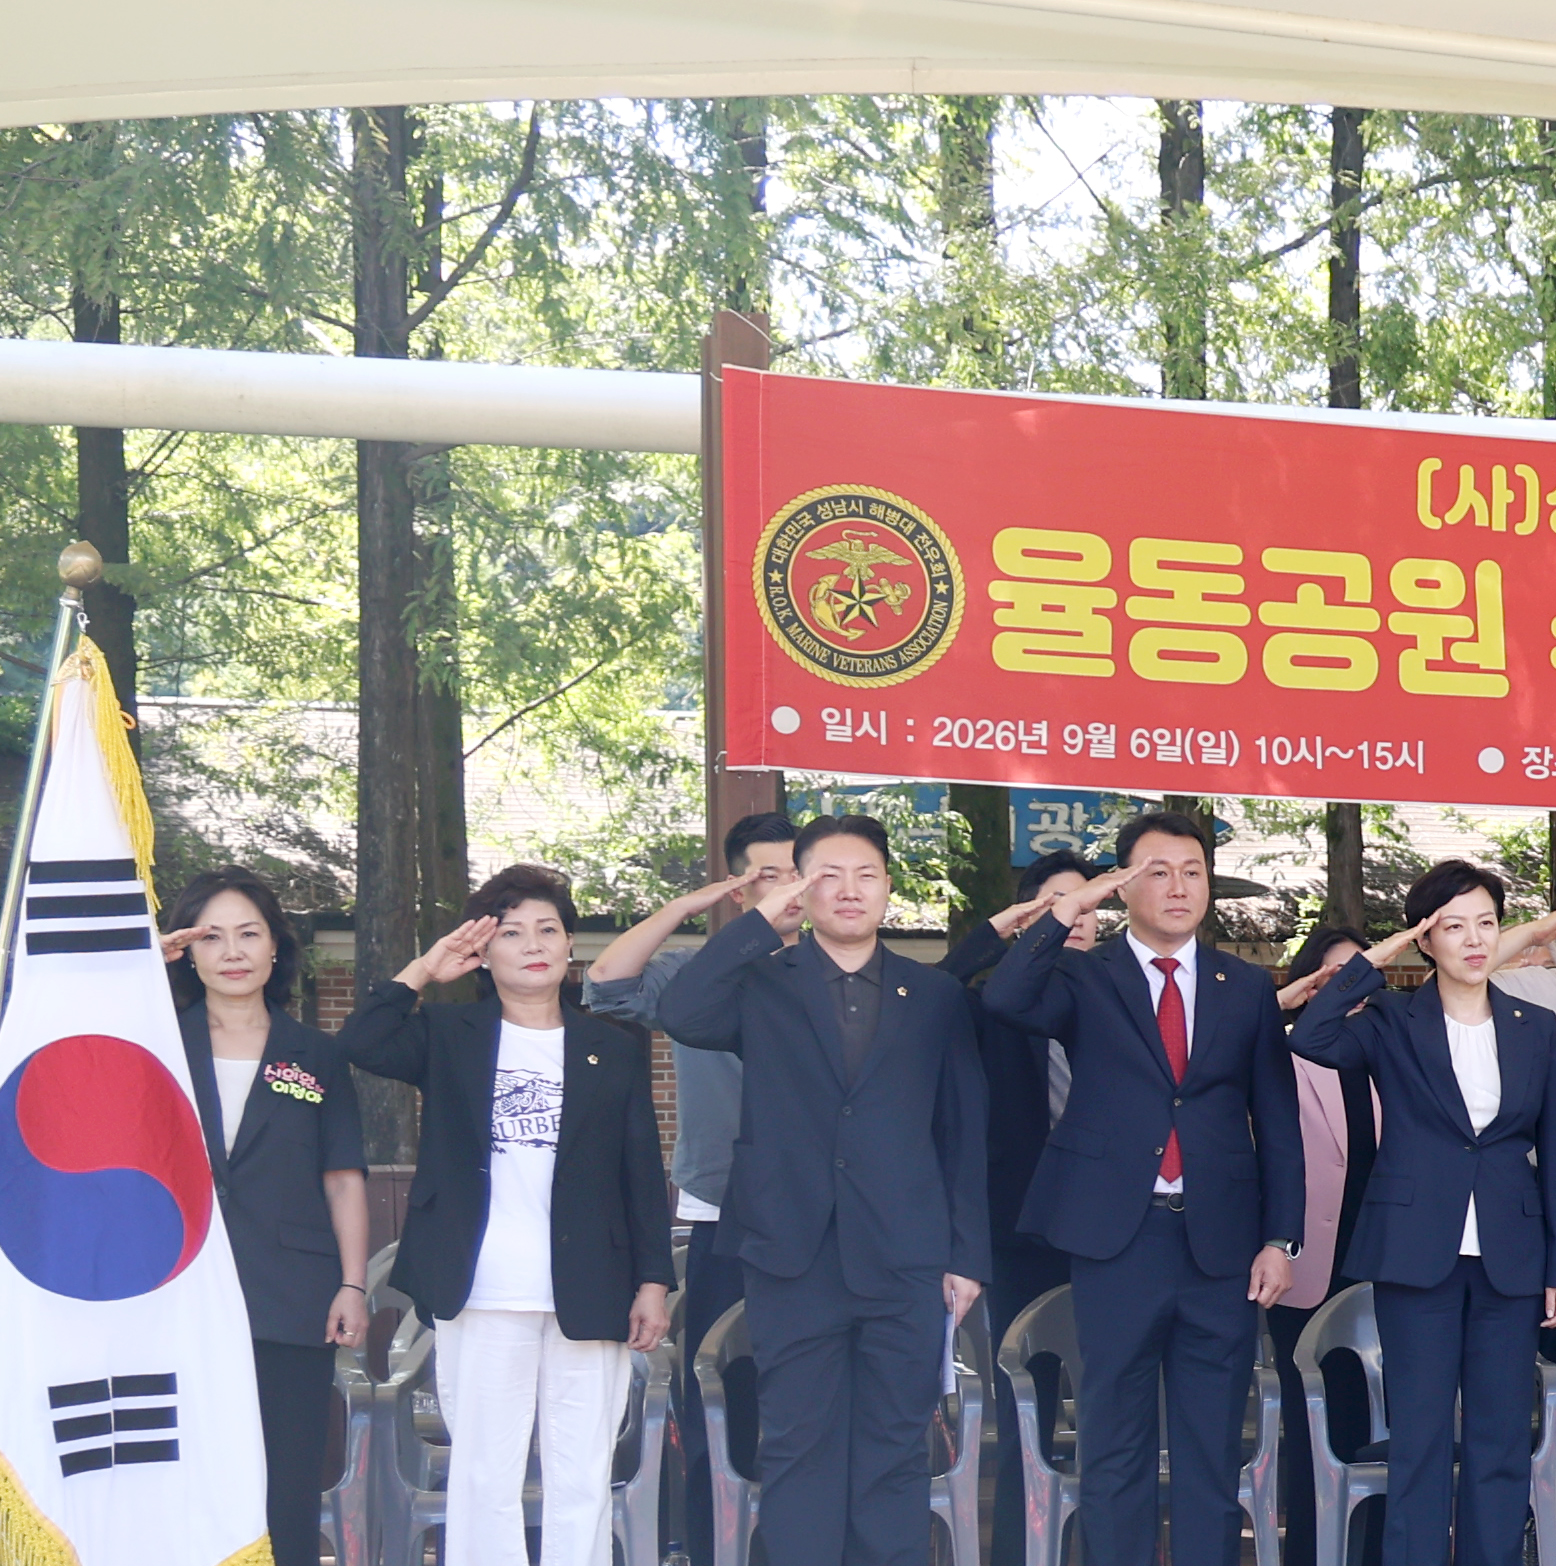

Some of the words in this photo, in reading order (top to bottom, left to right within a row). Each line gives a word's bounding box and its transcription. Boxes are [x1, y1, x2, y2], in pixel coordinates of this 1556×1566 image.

[771, 510, 816, 565] 대한민국
[815, 497, 865, 521] 성남시
[868, 501, 918, 537] 해병대
[912, 531, 949, 579] 전우회
[786, 623, 832, 663] MARINE
[833, 654, 898, 673] VETERANS
[901, 600, 949, 665] ASSOCIATION
[987, 526, 1511, 699] 율동공원
[820, 706, 887, 746] 일시
[931, 716, 1048, 756] 2026년
[1062, 721, 1117, 760] 9월
[1129, 727, 1241, 767] 6일(일)
[1254, 735, 1425, 775] 10시~15시
